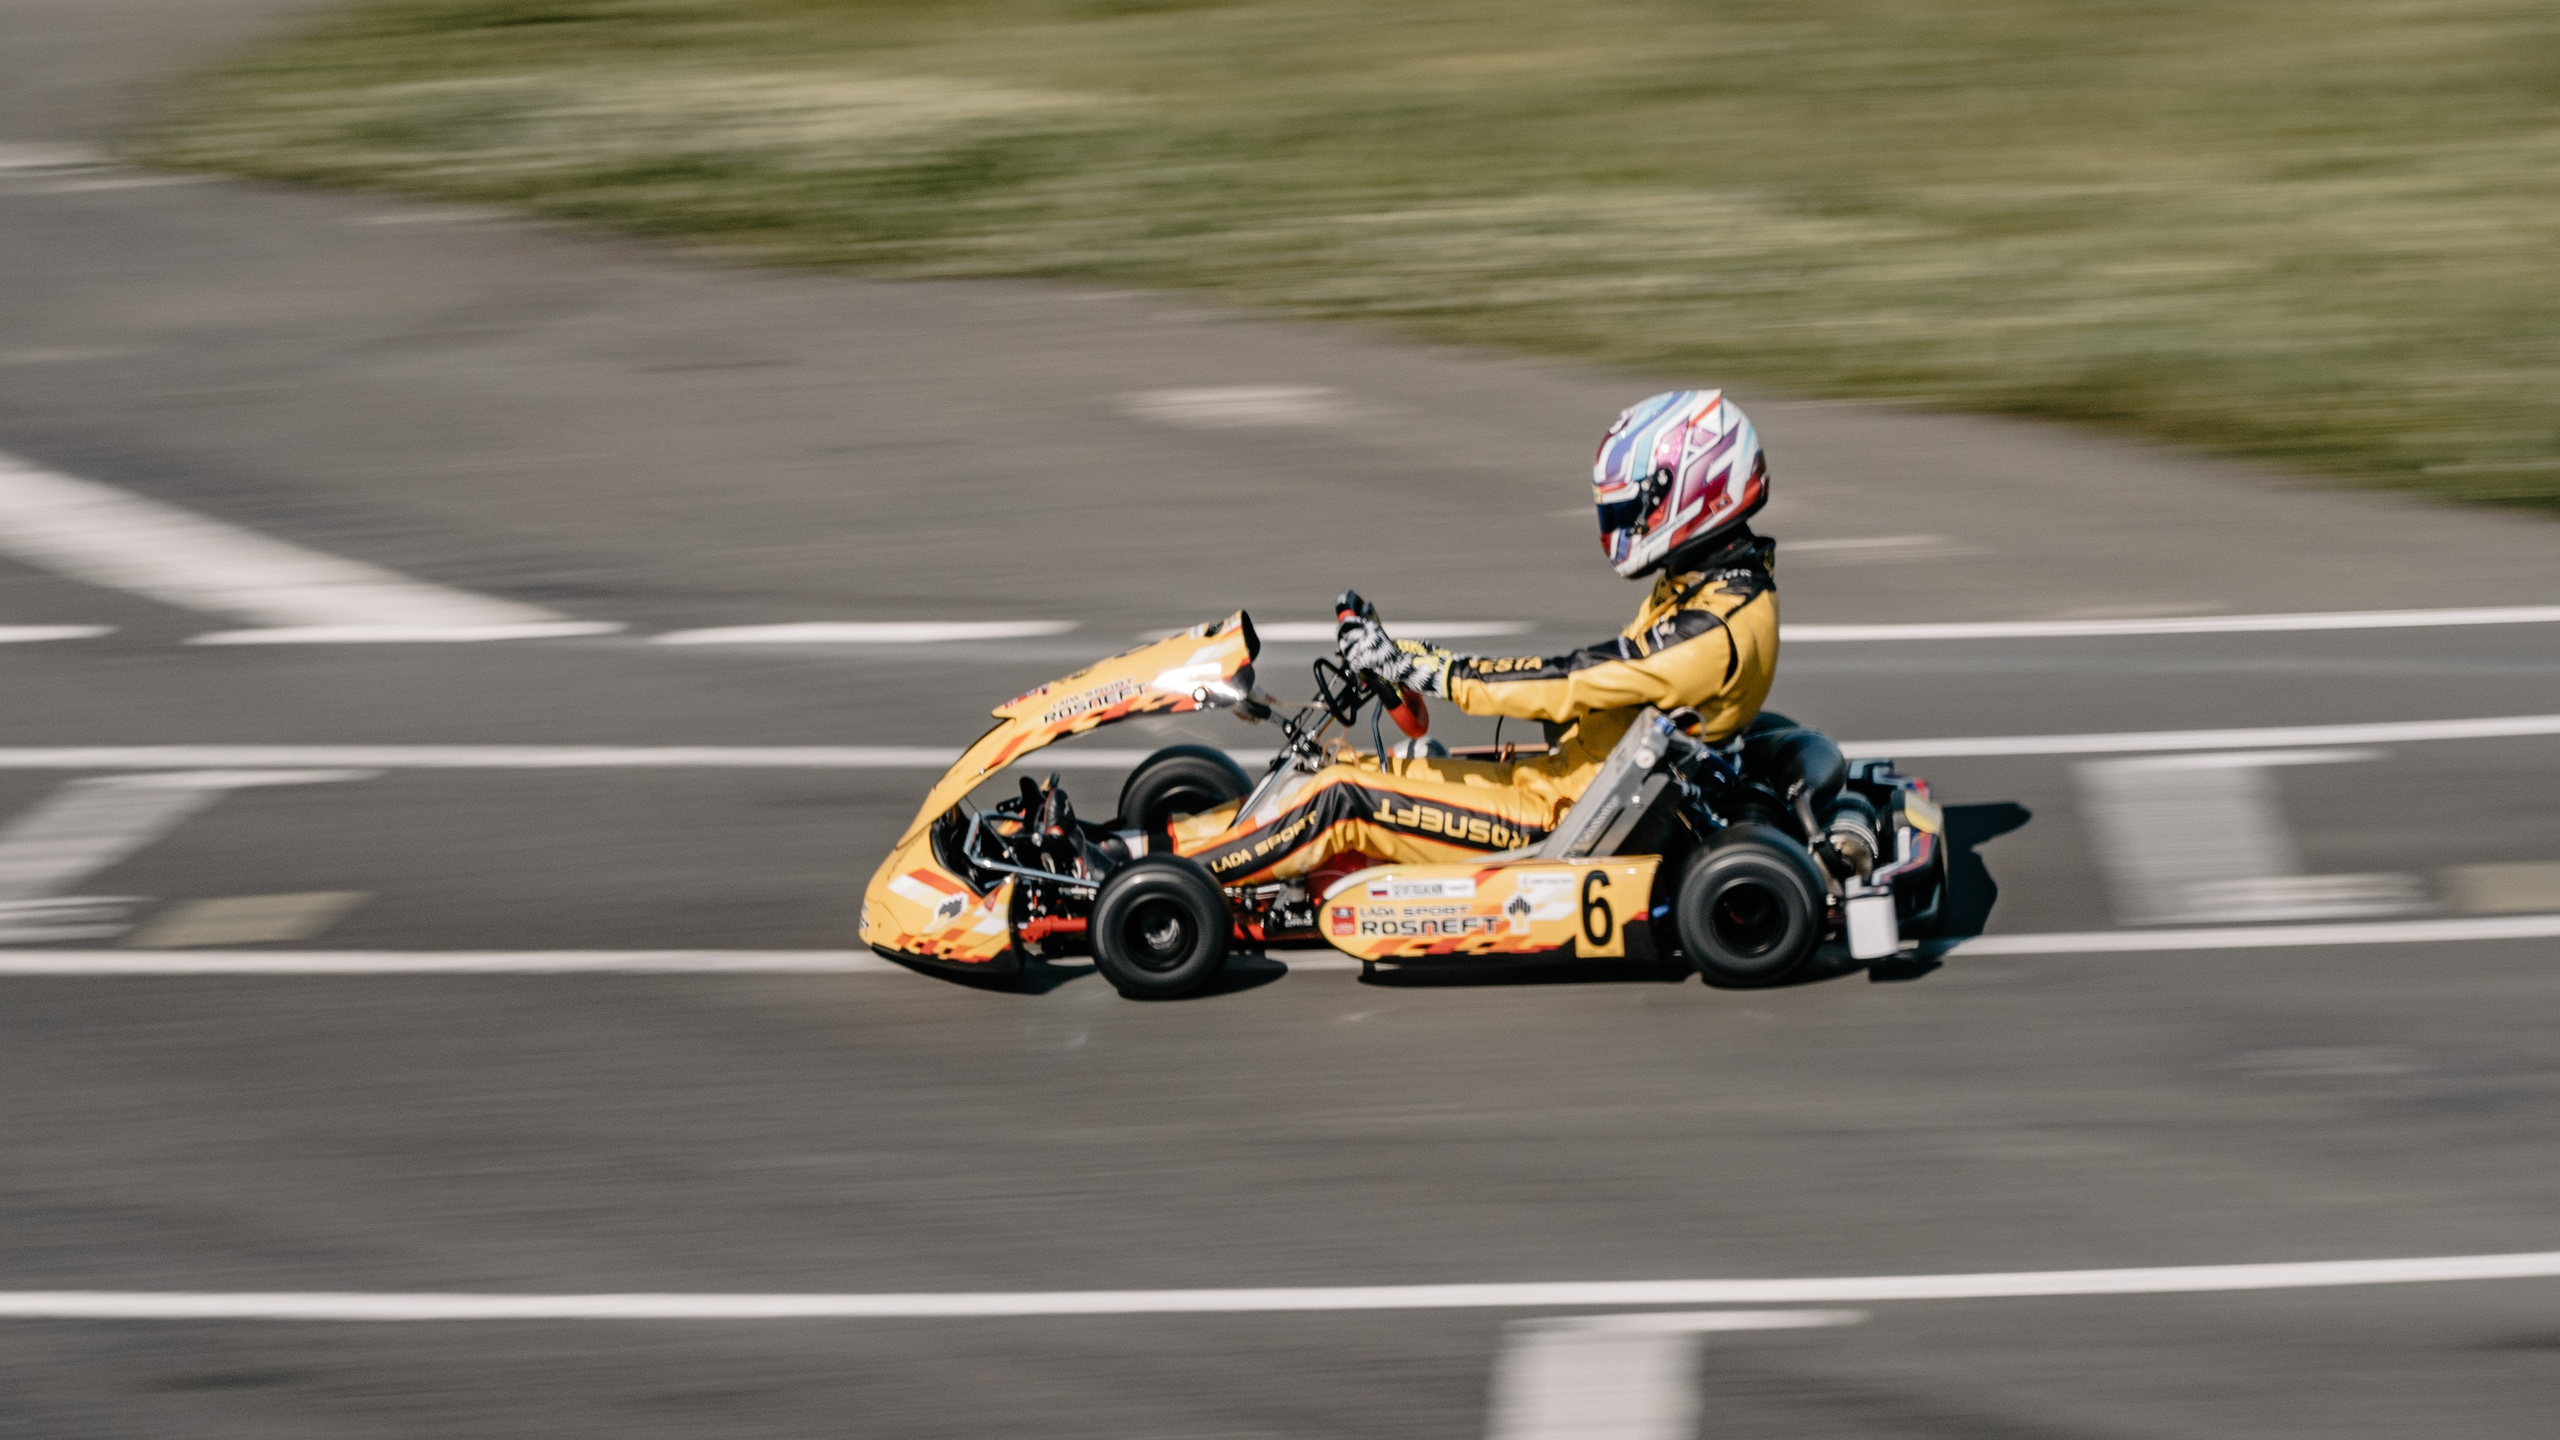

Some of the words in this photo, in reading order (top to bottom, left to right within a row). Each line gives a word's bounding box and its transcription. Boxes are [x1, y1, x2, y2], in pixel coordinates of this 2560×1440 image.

[1211, 848, 1252, 873] LADA
[1254, 809, 1317, 857] SPORT
[1359, 906, 1397, 918] LADA
[1402, 905, 1471, 917] SPORT
[1361, 917, 1499, 936] ROSNEFT
[1582, 870, 1613, 946] 6
